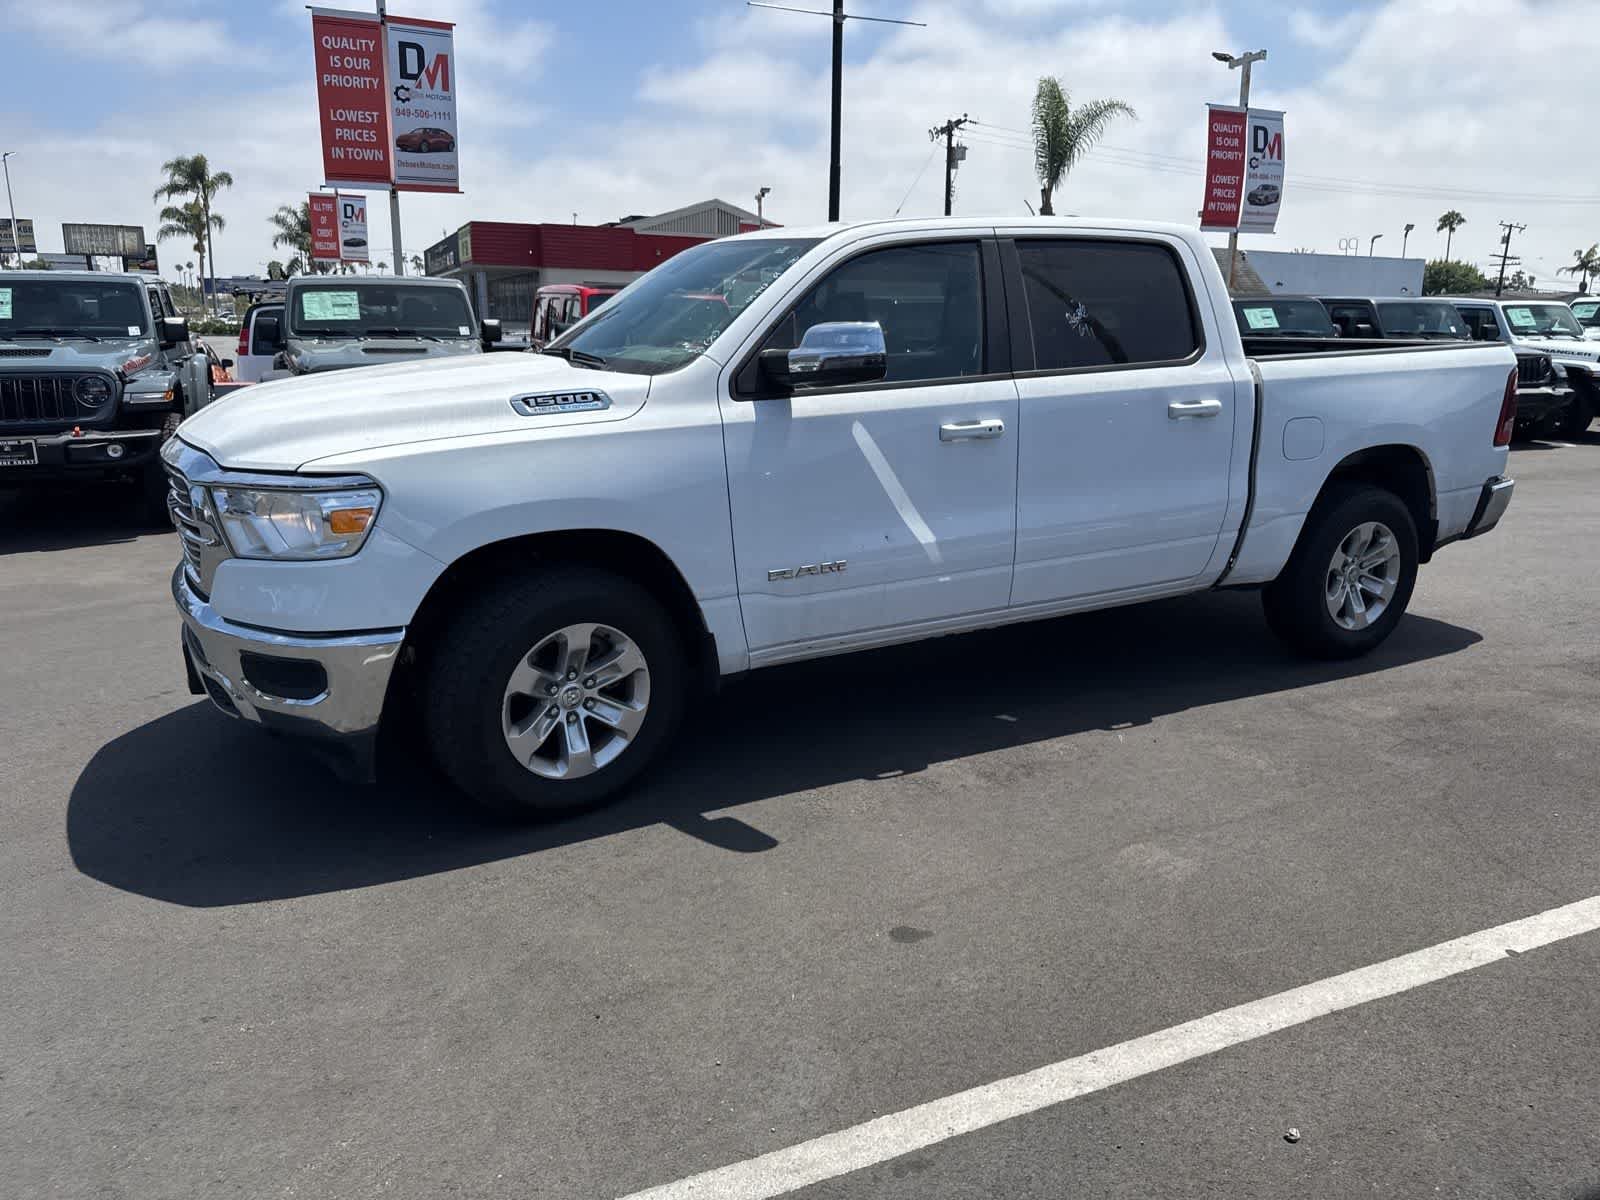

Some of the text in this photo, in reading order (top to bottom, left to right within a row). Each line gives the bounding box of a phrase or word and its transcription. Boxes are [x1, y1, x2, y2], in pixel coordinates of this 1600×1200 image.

[322, 35, 376, 52] QUALITY
[330, 55, 371, 70] IS OUR
[323, 74, 380, 90] PRIORITY
[330, 108, 379, 124] LOWEST
[1213, 122, 1242, 133] QUALITY
[336, 129, 377, 142] PRICES
[1216, 137, 1239, 147] IS OUR
[331, 147, 384, 161] IN TOWN
[1211, 150, 1242, 160] PRIORITY
[1212, 175, 1240, 185] LOWEST
[1213, 188, 1236, 198] PRICES
[1208, 202, 1237, 212] IN TOWN
[526, 392, 594, 407] 1500
[768, 560, 847, 581] RAM
